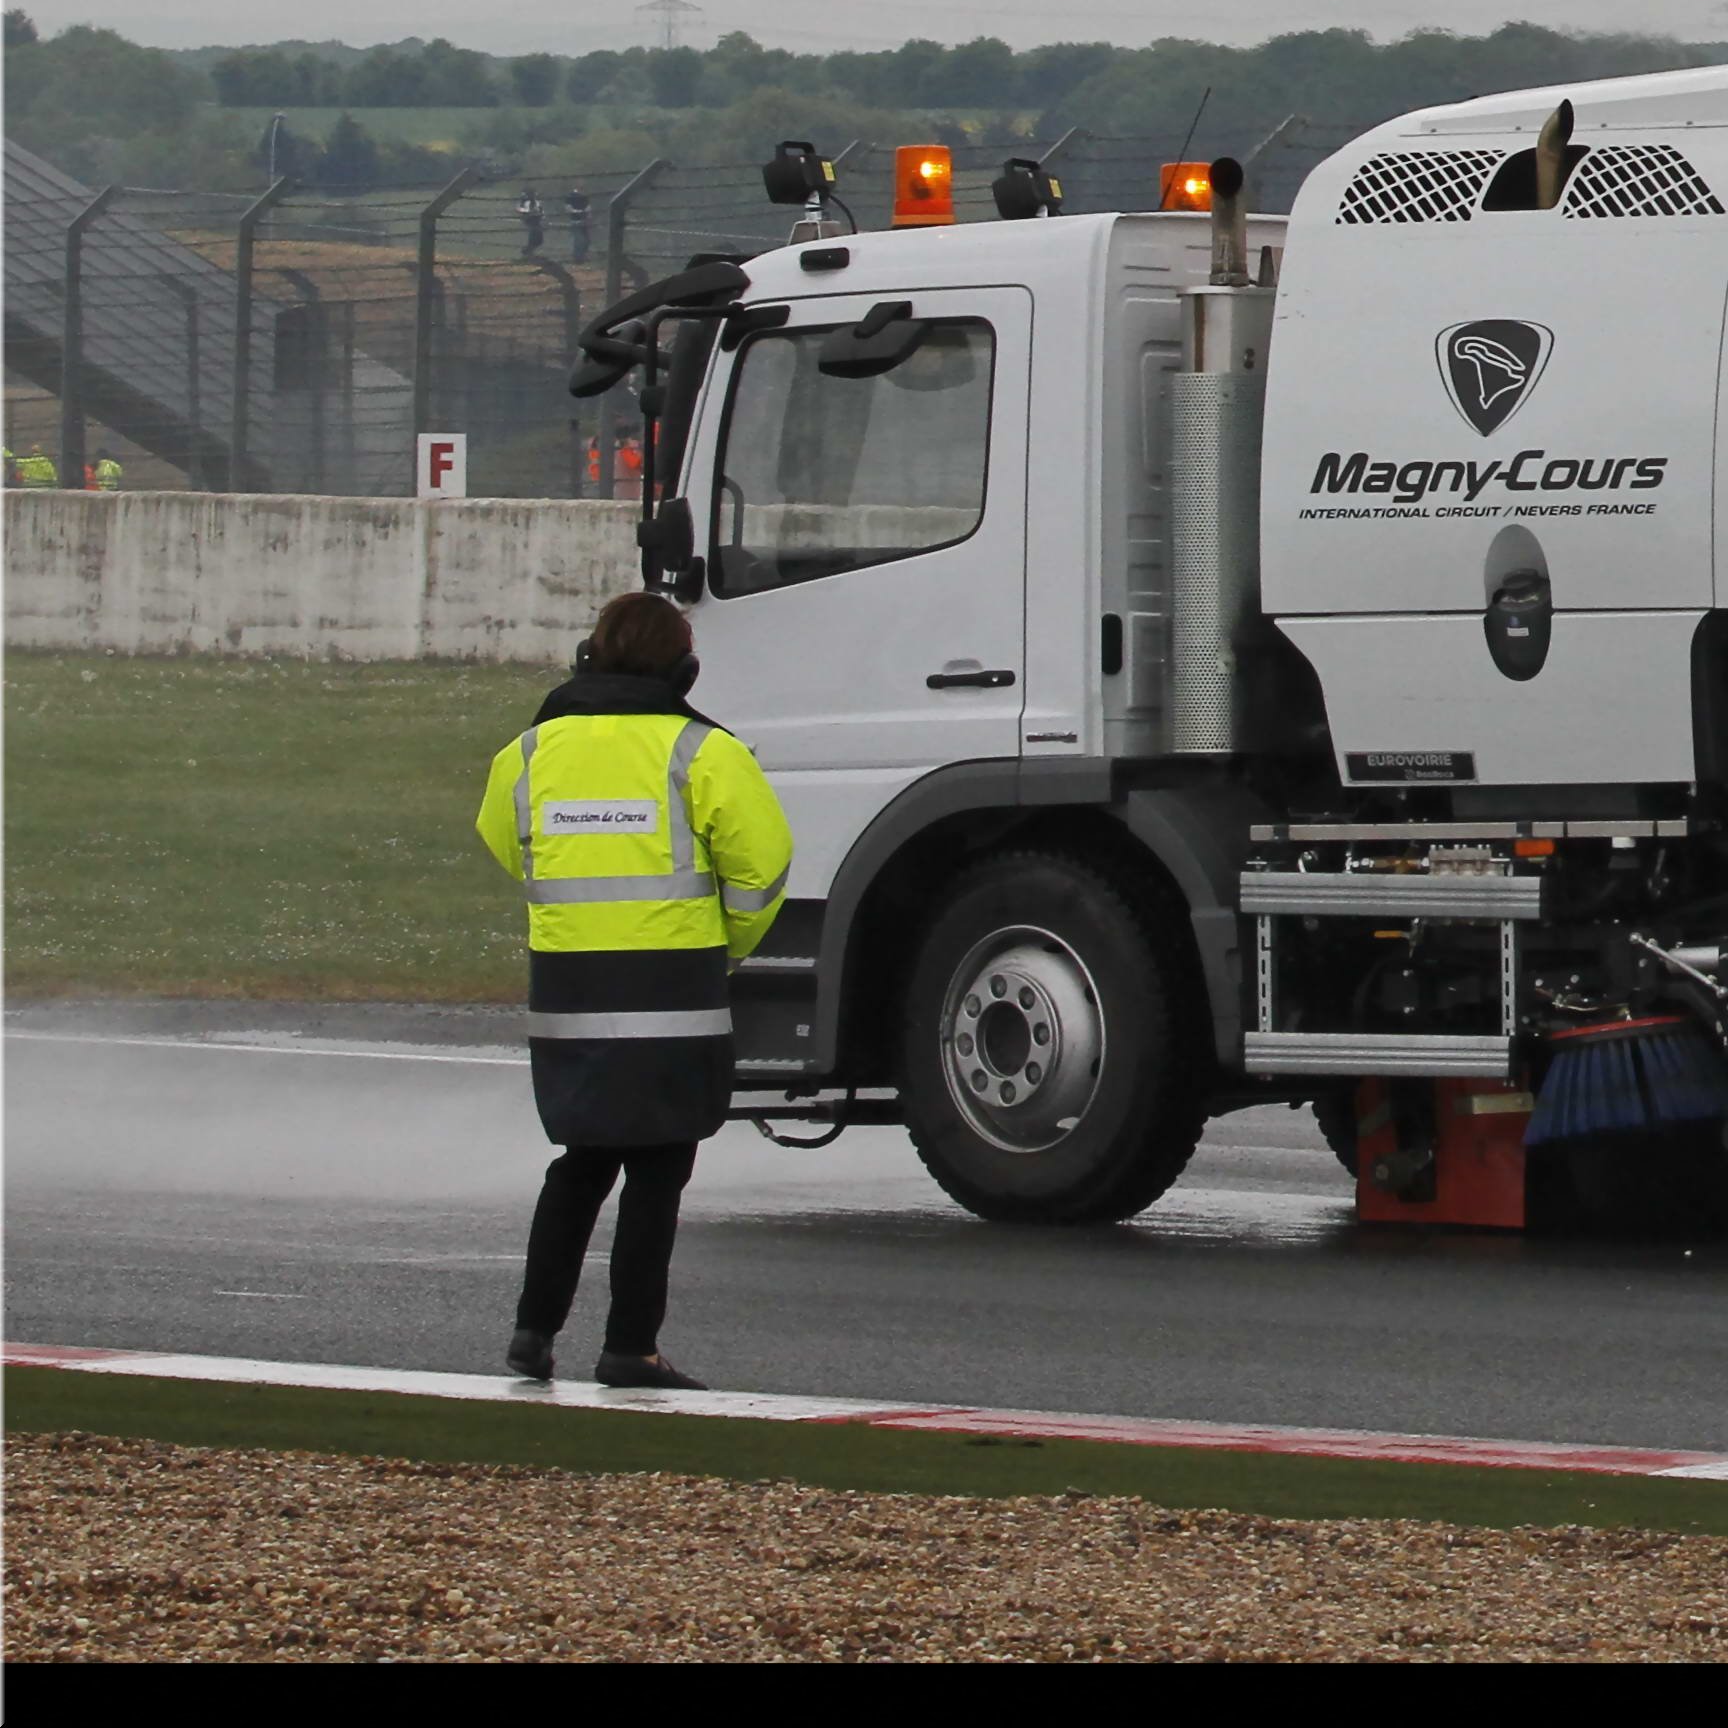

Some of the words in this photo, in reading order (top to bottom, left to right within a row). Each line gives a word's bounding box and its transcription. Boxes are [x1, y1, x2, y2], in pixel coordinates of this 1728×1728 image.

[431, 443, 454, 488] F
[1310, 449, 1668, 503] Magny-Cours
[1299, 507, 1430, 520] INTERNATIONAL
[1435, 506, 1502, 518] CIRCUIT
[1514, 505, 1582, 517] NEVERS
[1586, 503, 1657, 516] FRANCE
[1366, 754, 1453, 767] EUROVOIRIE
[552, 812, 600, 824] Direction
[602, 811, 613, 823] de
[615, 812, 648, 823] Course
